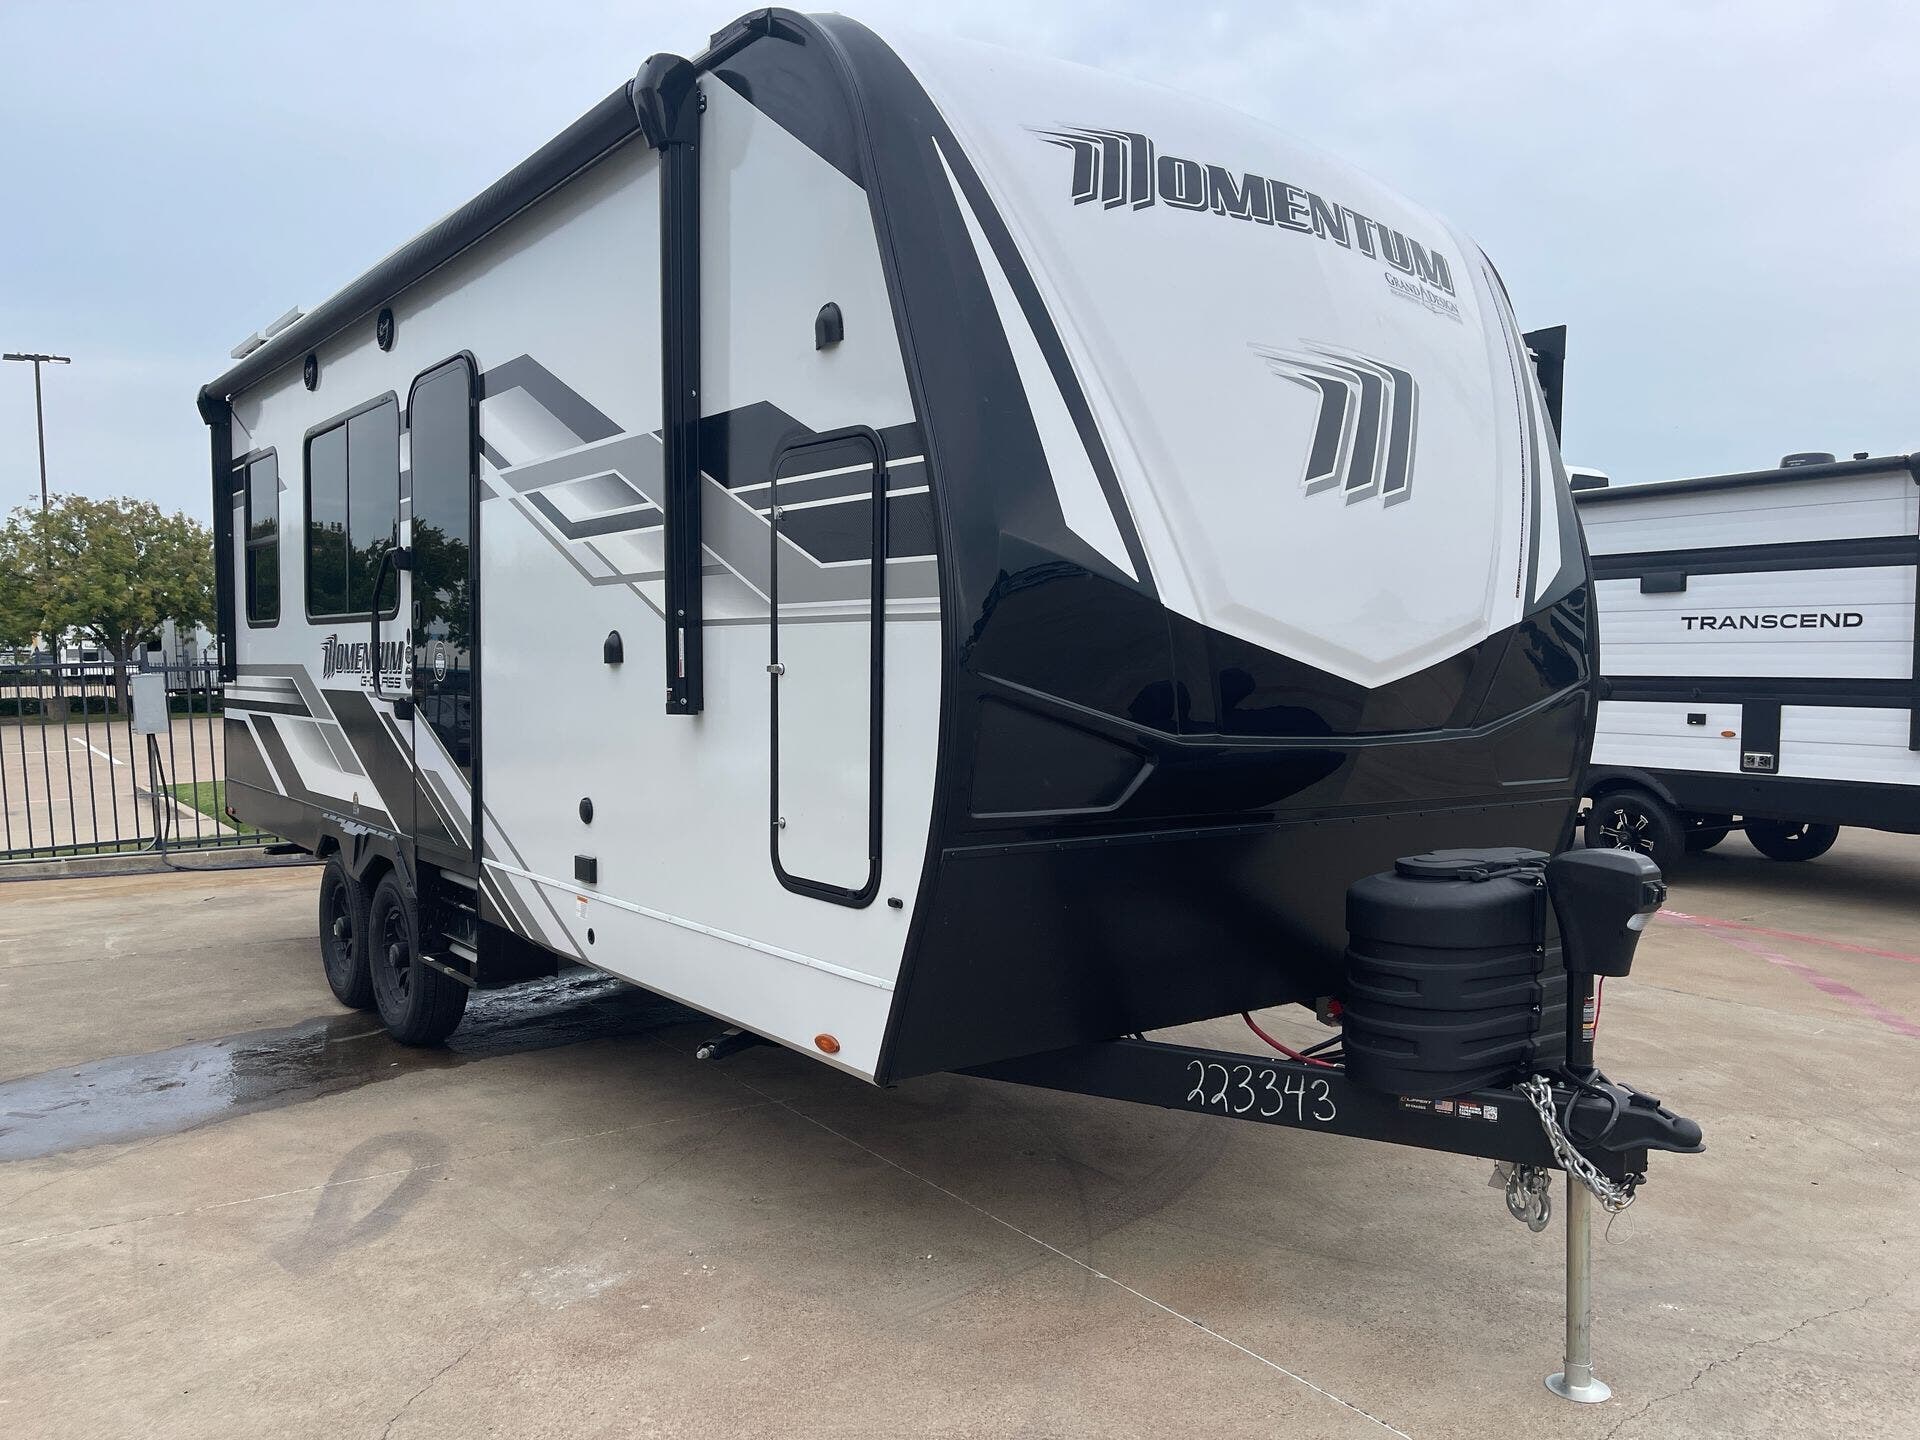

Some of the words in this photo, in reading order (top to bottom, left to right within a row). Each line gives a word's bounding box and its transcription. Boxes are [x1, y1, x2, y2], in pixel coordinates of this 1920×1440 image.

[1033, 126, 1455, 297] MOMENTUM
[1384, 272, 1421, 296] GRAND
[1681, 612, 1864, 630] TRANSCEND
[320, 633, 404, 680] MOMENUM
[1187, 1060, 1336, 1122] 223343
